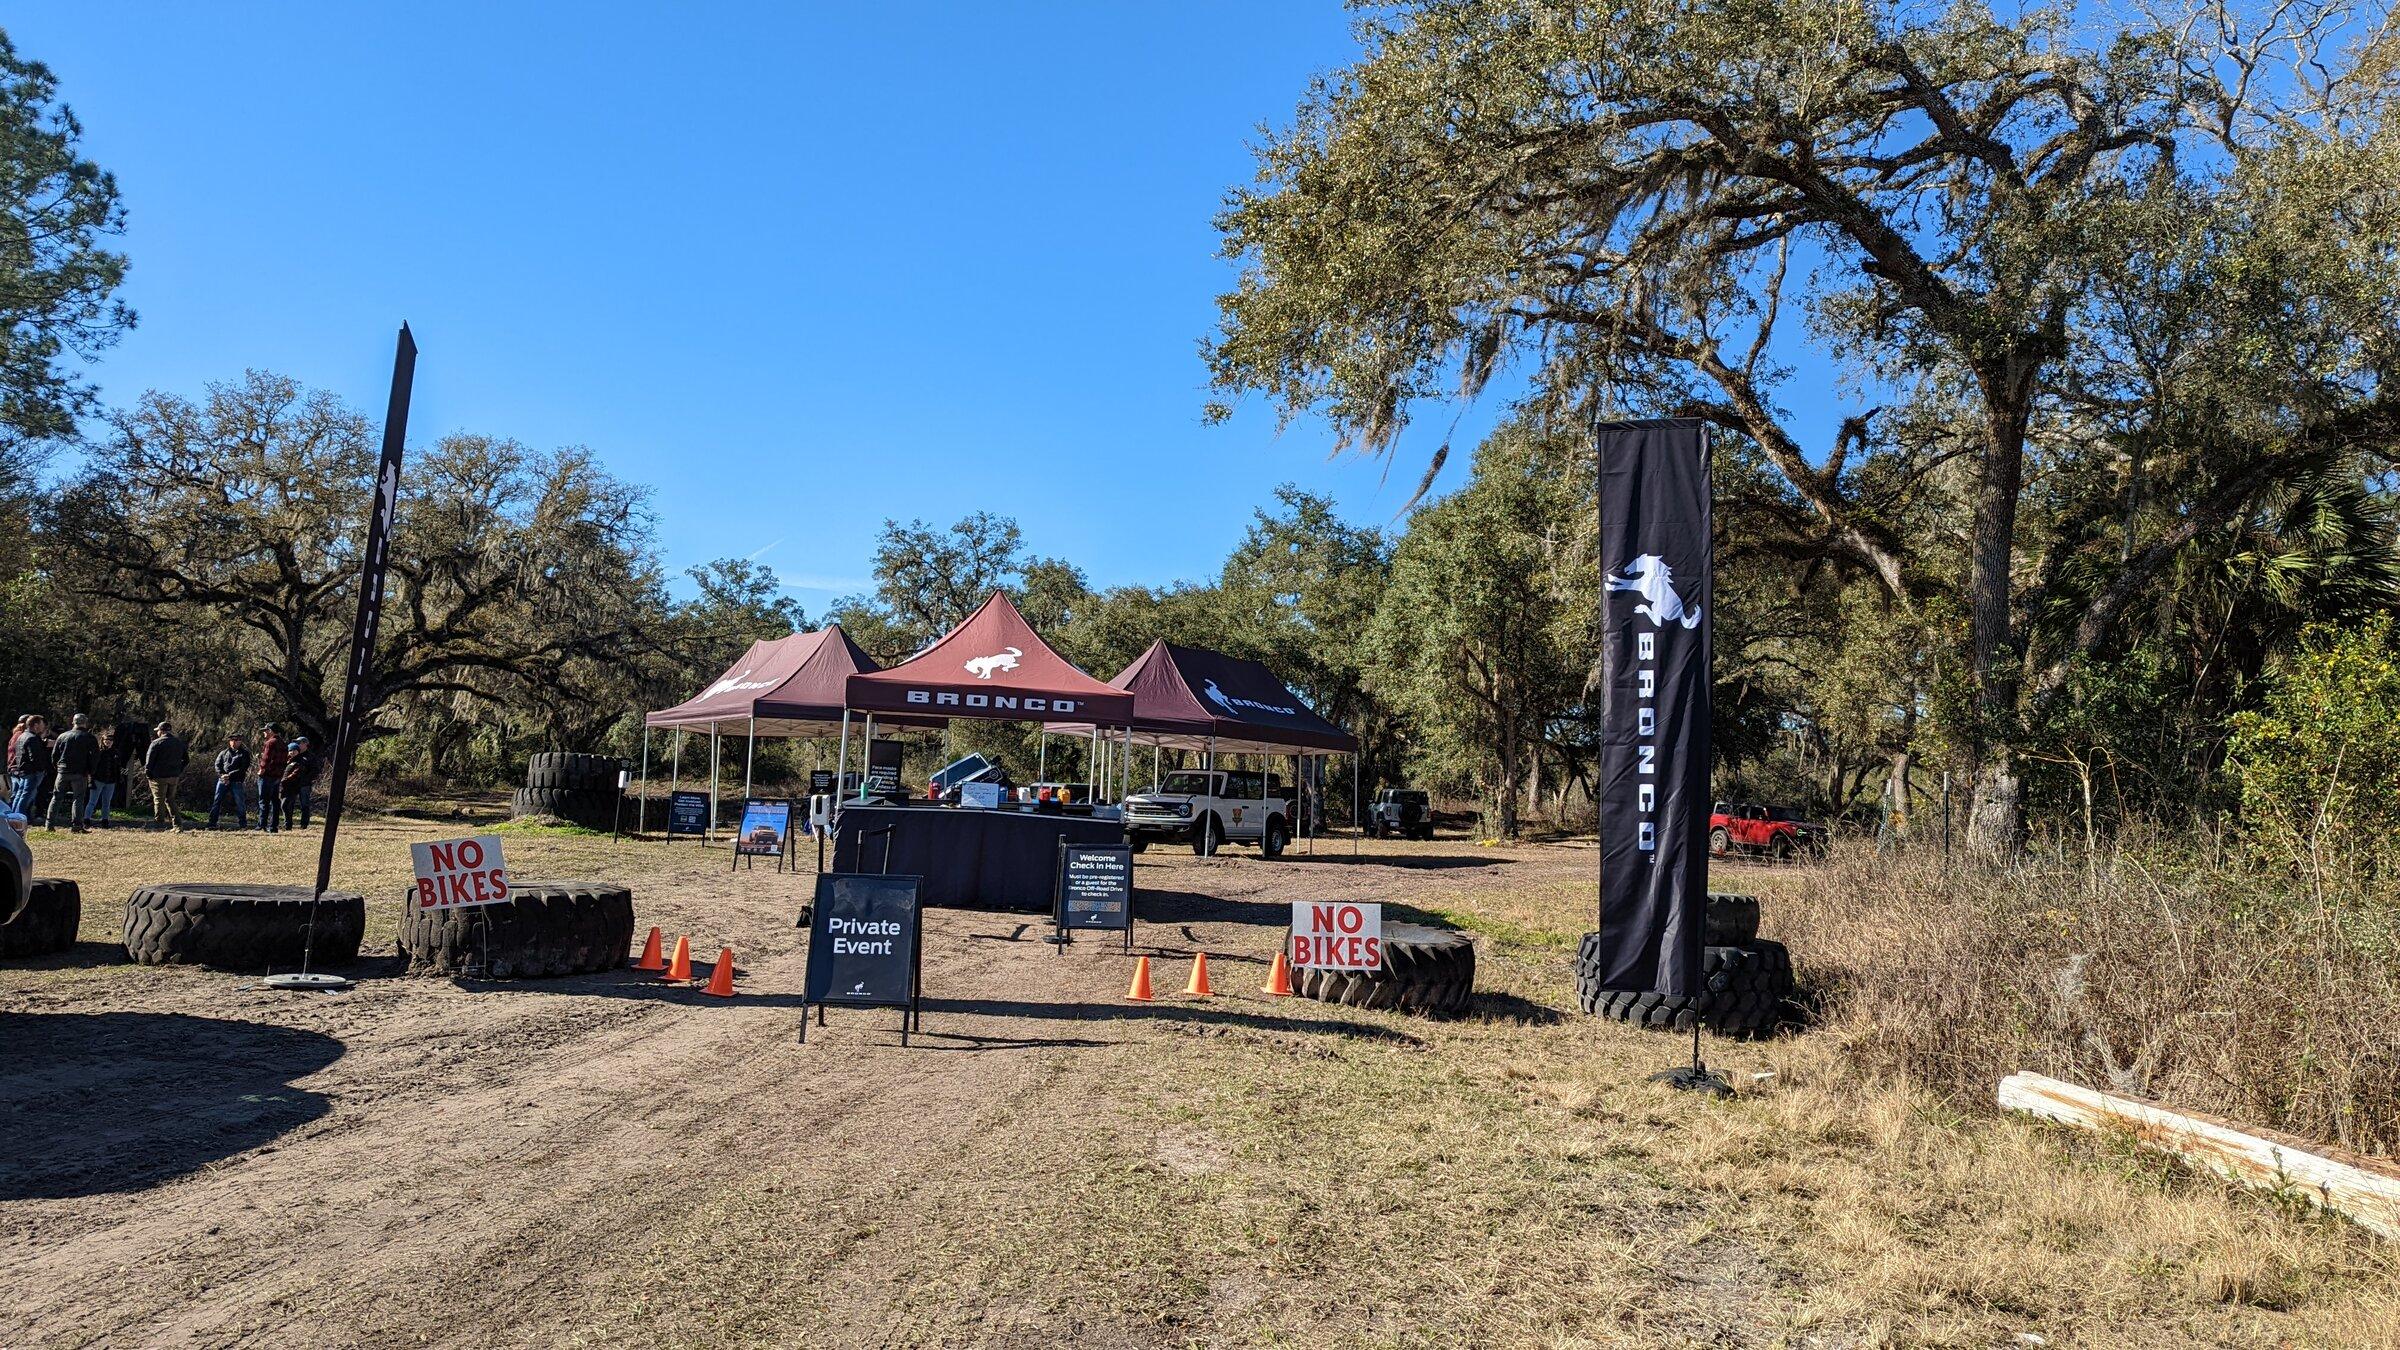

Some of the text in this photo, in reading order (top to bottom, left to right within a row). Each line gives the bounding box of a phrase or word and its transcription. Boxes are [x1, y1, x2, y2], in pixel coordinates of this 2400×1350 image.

[907, 690, 1075, 713] BRONCO
[1231, 698, 1296, 715] BRONCO
[1638, 632, 1655, 851] BRONCO
[429, 840, 484, 873] NO
[1070, 862, 1124, 871] Check In Here
[1079, 854, 1117, 862] Welcome
[417, 869, 507, 908] BIKES
[828, 917, 901, 936] Private
[1311, 905, 1363, 934] NO
[833, 937, 892, 955] Event
[1293, 935, 1381, 967] BIKES
